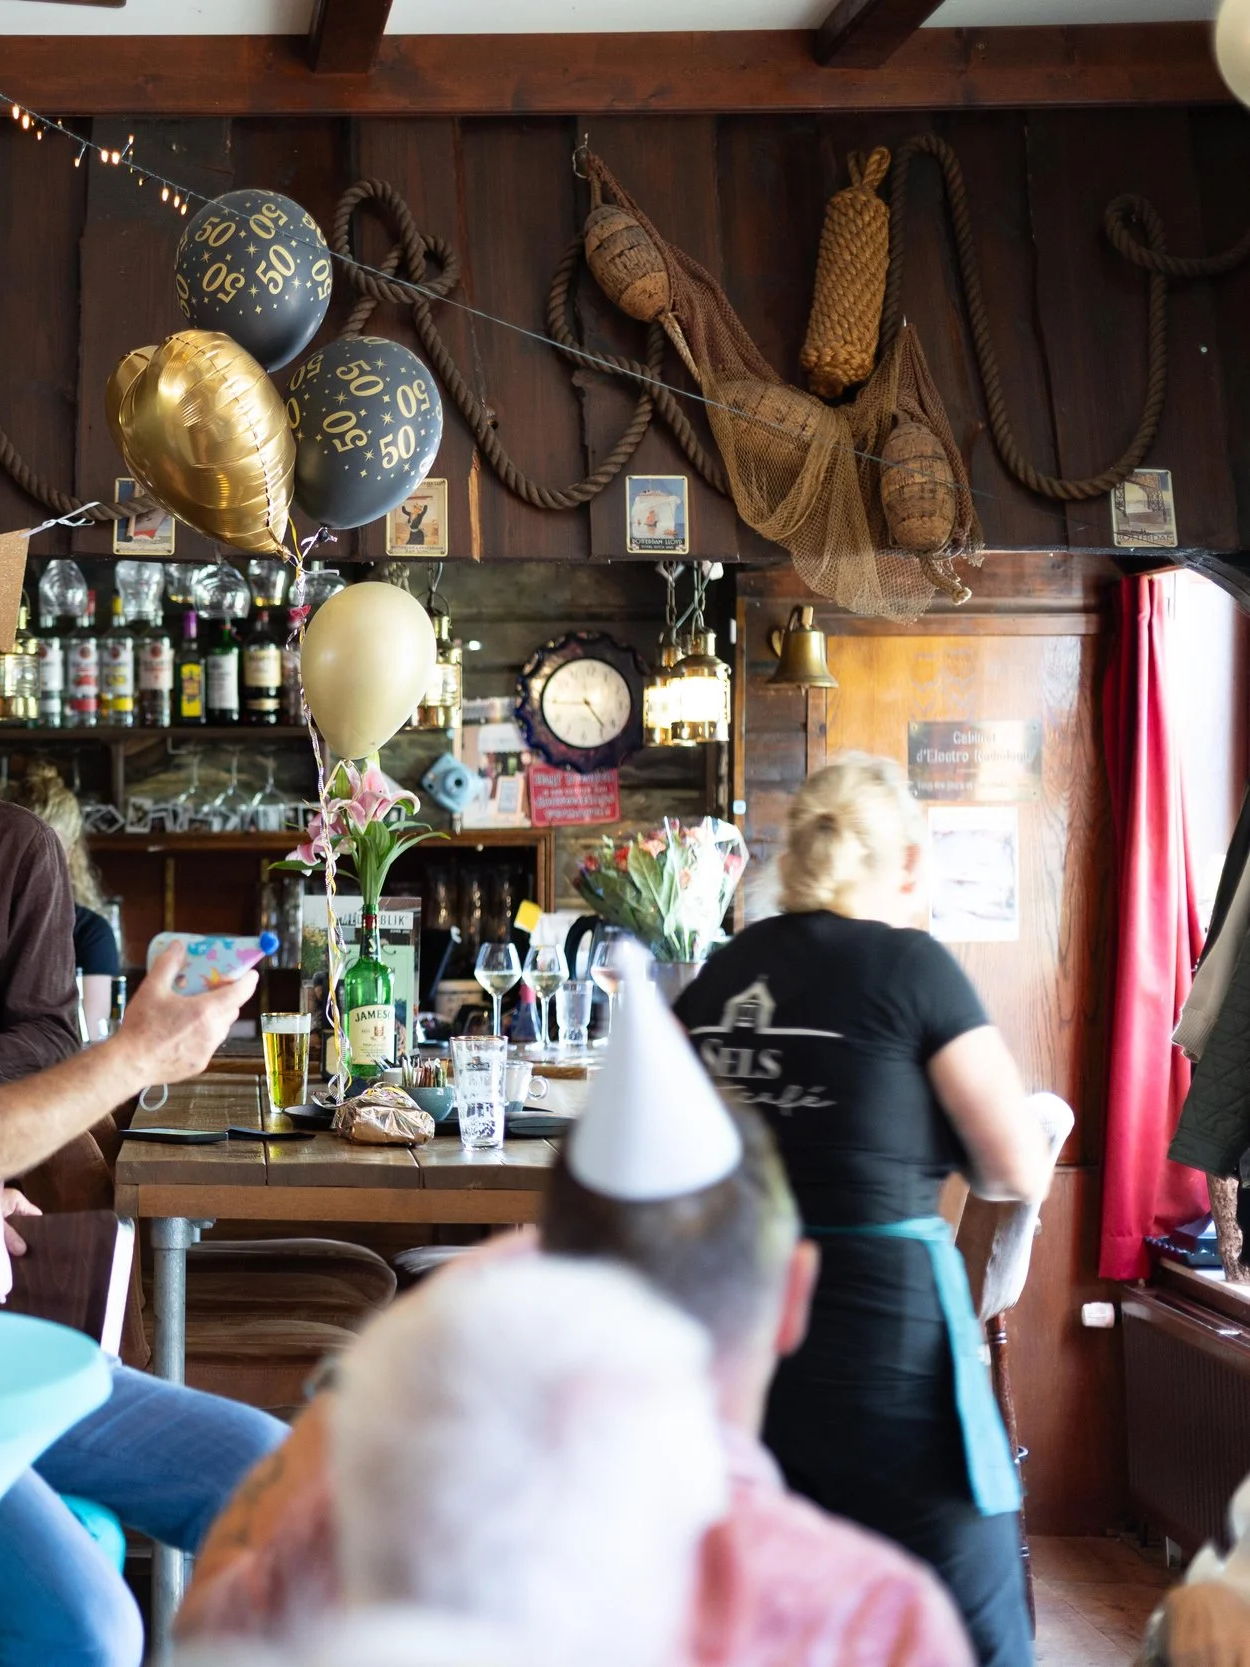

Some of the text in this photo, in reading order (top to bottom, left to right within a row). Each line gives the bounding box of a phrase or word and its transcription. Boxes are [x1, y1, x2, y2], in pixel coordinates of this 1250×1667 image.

[194, 216, 236, 248] 50
[249, 203, 289, 240] 50
[201, 262, 246, 304] 50
[255, 244, 296, 295] 50
[311, 258, 332, 301] 50
[289, 353, 325, 392] 50
[335, 359, 384, 397] 50
[396, 379, 431, 419] 50
[322, 410, 368, 453] 50
[379, 425, 416, 469] 50
